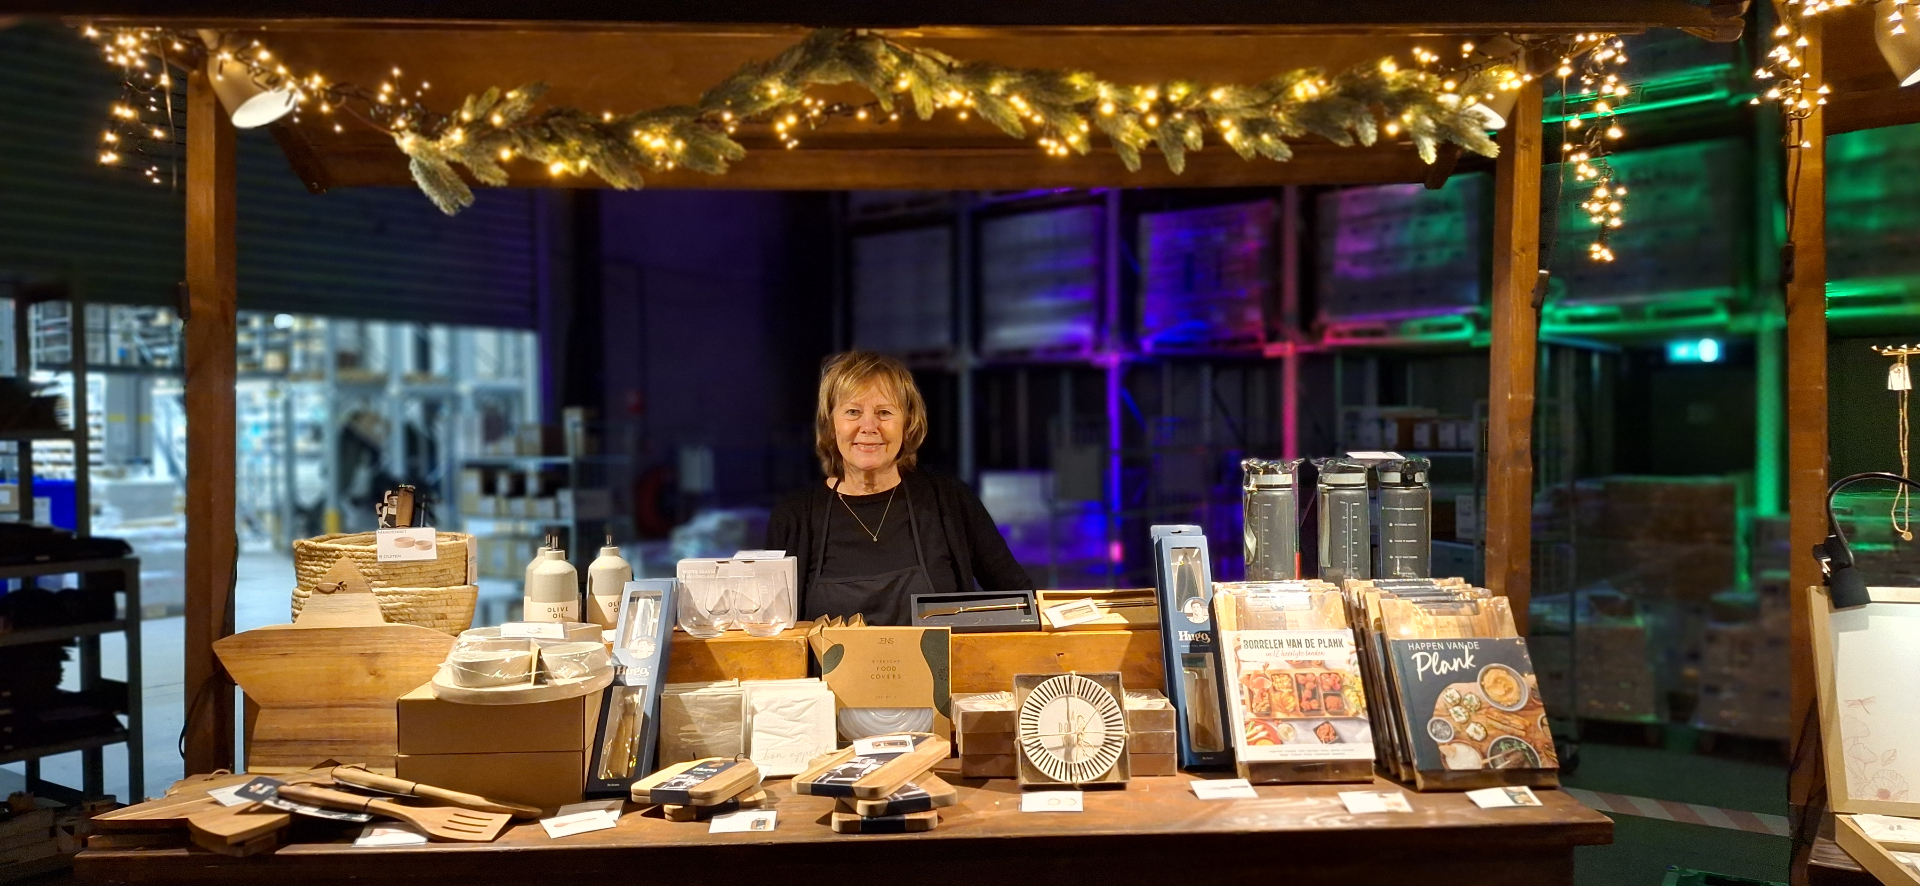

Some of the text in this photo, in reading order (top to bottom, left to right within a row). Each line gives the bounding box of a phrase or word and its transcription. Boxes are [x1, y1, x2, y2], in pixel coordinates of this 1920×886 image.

[546, 605, 569, 613] OLIVE
[878, 637, 895, 645] JENS
[1243, 638, 1345, 650] BORRELEN VAN DE PLANK
[1407, 641, 1480, 651] HAPPEN VAN DE
[1411, 644, 1476, 682] Plank
[762, 748, 785, 760] bon
